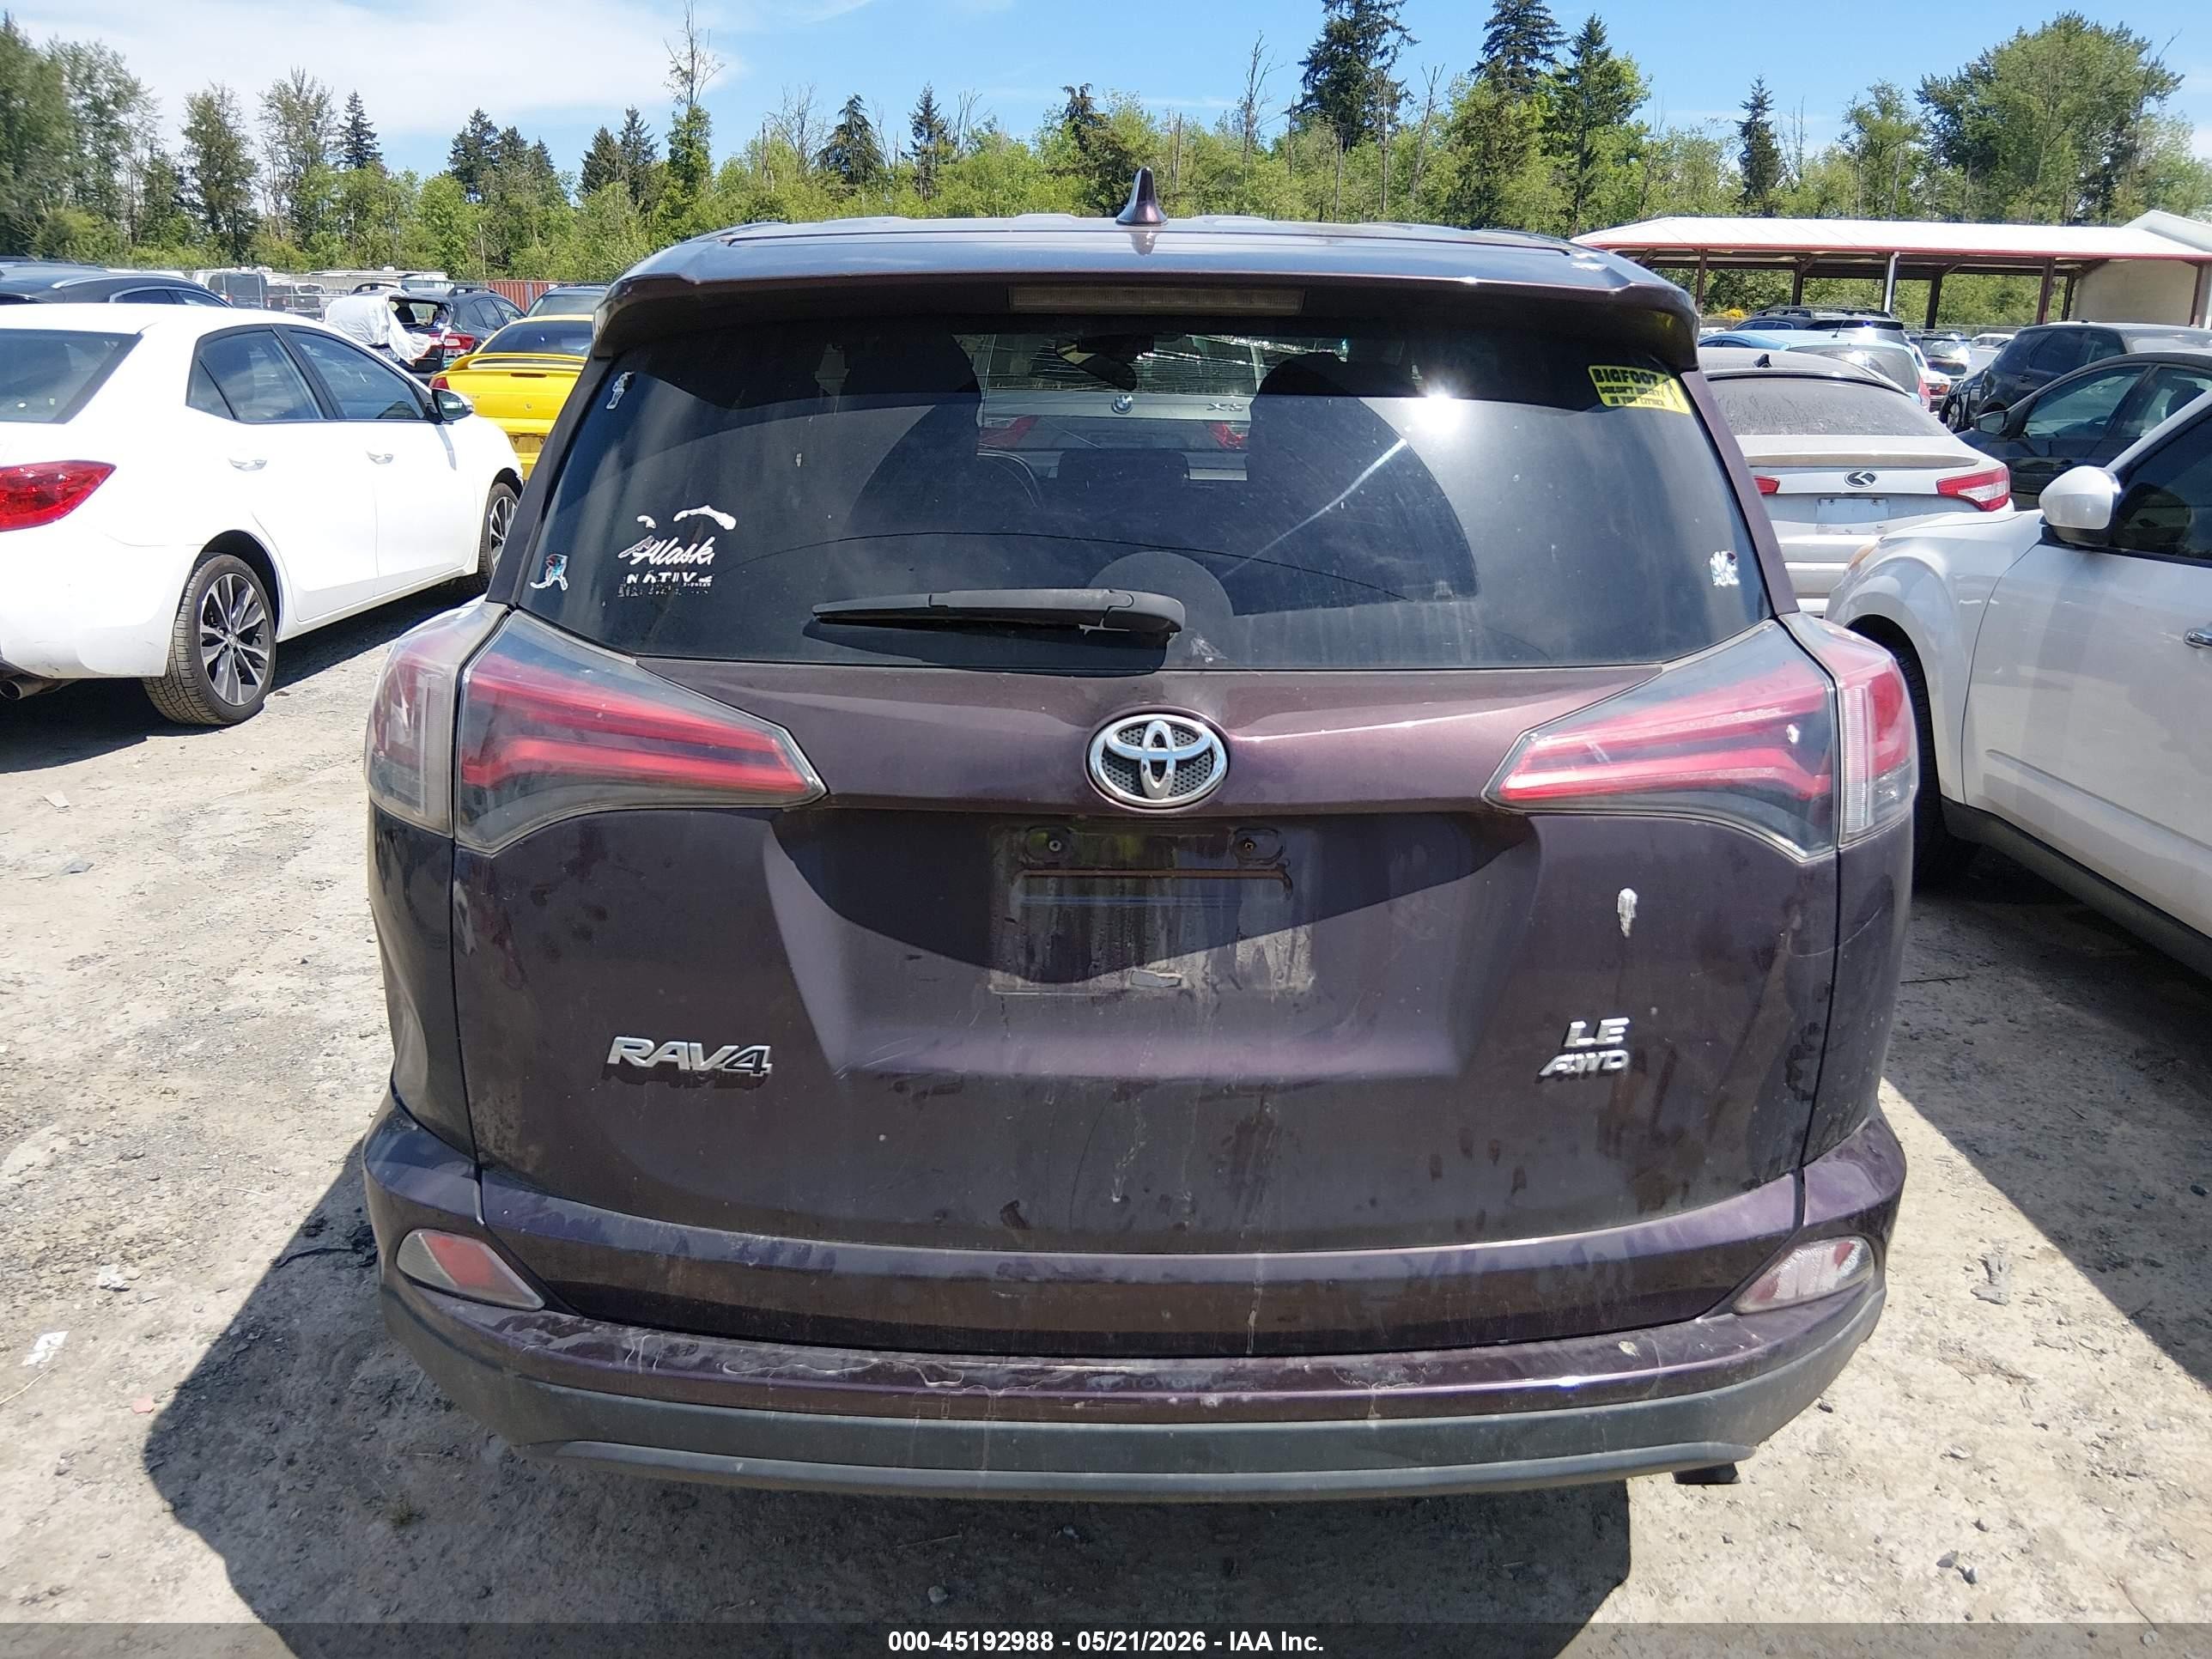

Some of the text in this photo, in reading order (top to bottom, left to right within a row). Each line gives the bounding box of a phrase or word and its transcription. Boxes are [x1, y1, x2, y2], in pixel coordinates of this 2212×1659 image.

[1591, 368, 1658, 385] BIGFOOT
[1562, 1018, 1630, 1047] LE
[607, 1036, 773, 1077] RAV4
[1538, 1049, 1630, 1077] AWD
